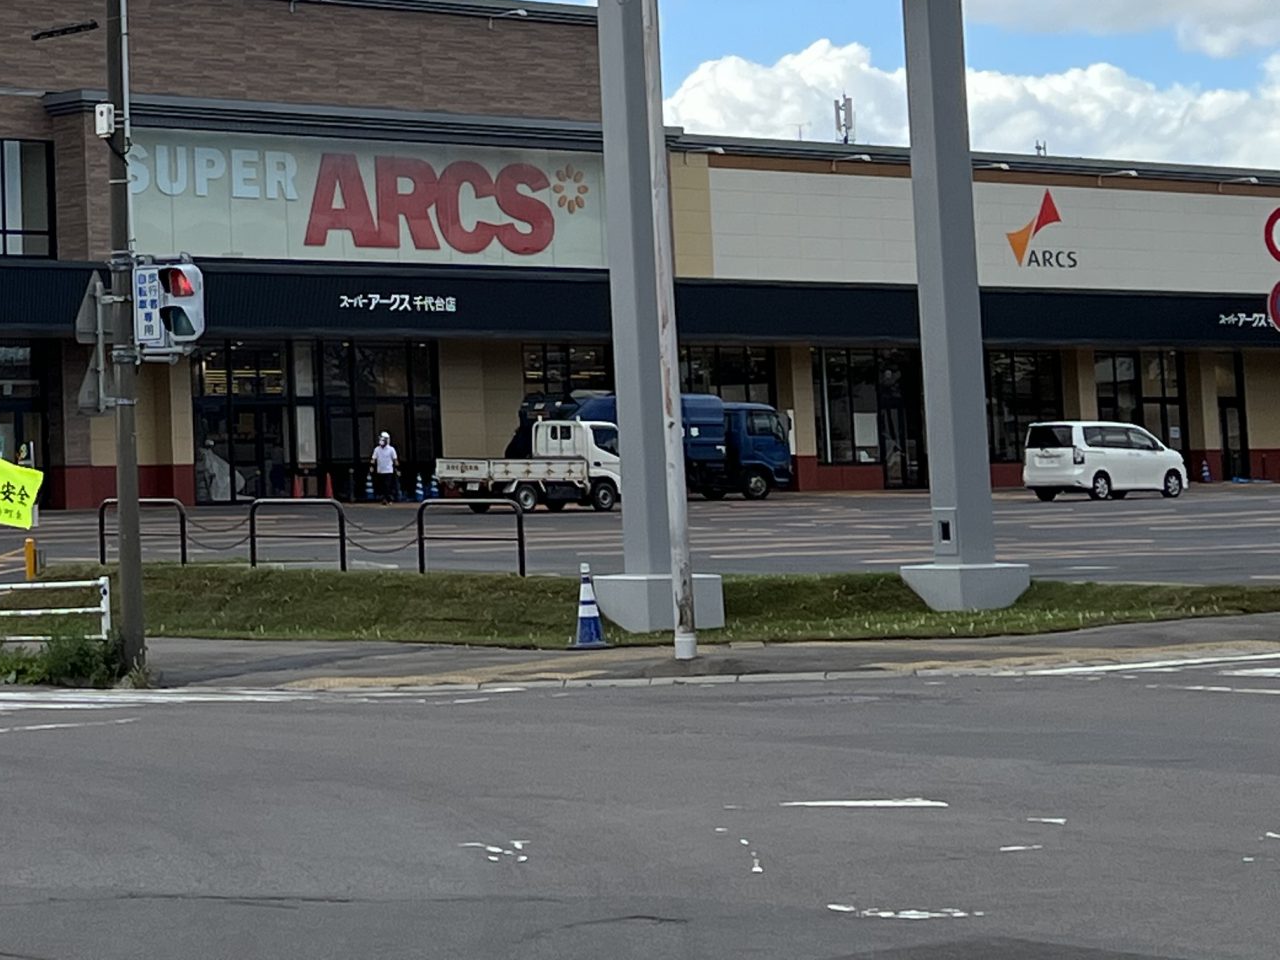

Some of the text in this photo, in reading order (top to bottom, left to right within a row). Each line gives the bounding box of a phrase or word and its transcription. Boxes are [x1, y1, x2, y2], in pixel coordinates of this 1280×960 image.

[127, 143, 555, 255] SUPER ARCS
[1027, 249, 1078, 269] ARCS
